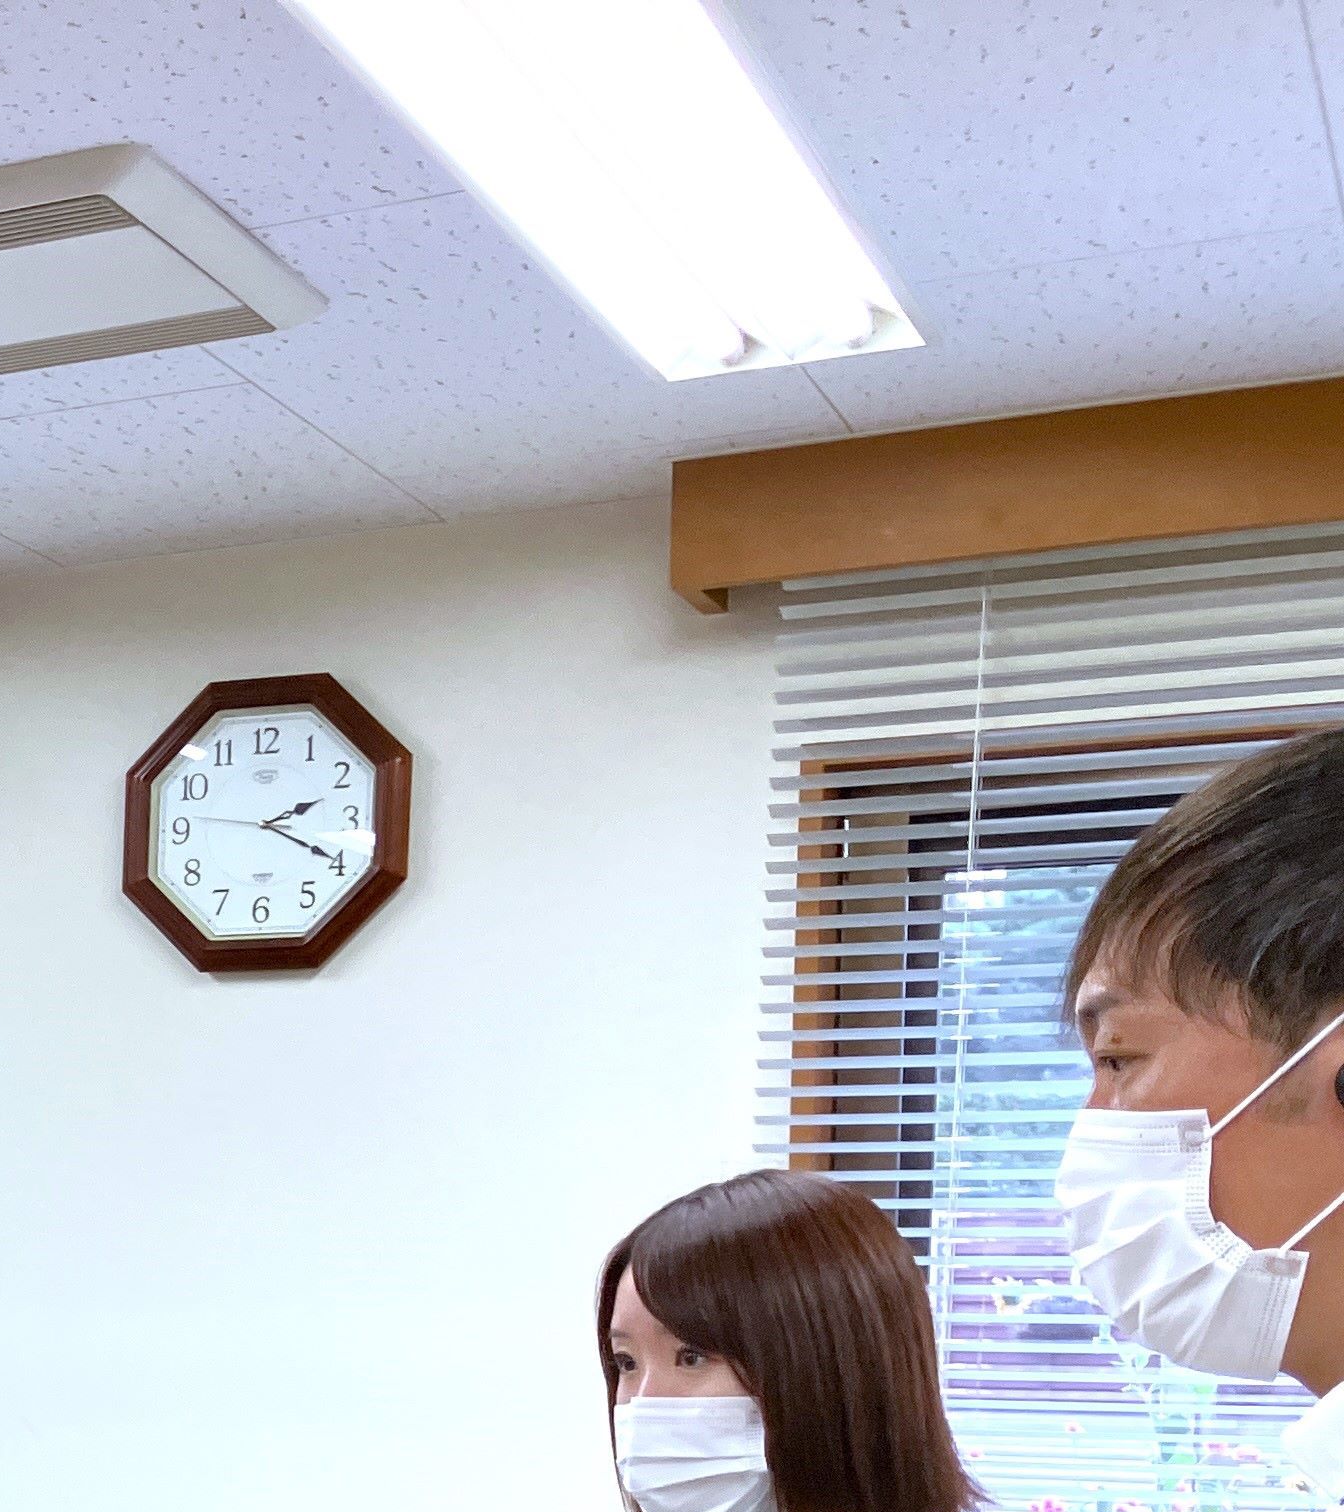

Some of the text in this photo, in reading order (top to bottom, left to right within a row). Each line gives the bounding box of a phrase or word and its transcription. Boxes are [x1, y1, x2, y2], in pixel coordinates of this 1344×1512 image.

[213, 739, 233, 767] 11
[252, 727, 280, 755] 12
[304, 735, 316, 762] 1
[181, 773, 209, 801] 10
[334, 761, 351, 789] 2
[172, 816, 190, 845] 9
[343, 805, 359, 831] 3
[184, 858, 201, 887] 8
[328, 849, 346, 877] 4
[213, 889, 230, 916] 7
[299, 880, 316, 909] 5
[252, 896, 270, 924] 6
